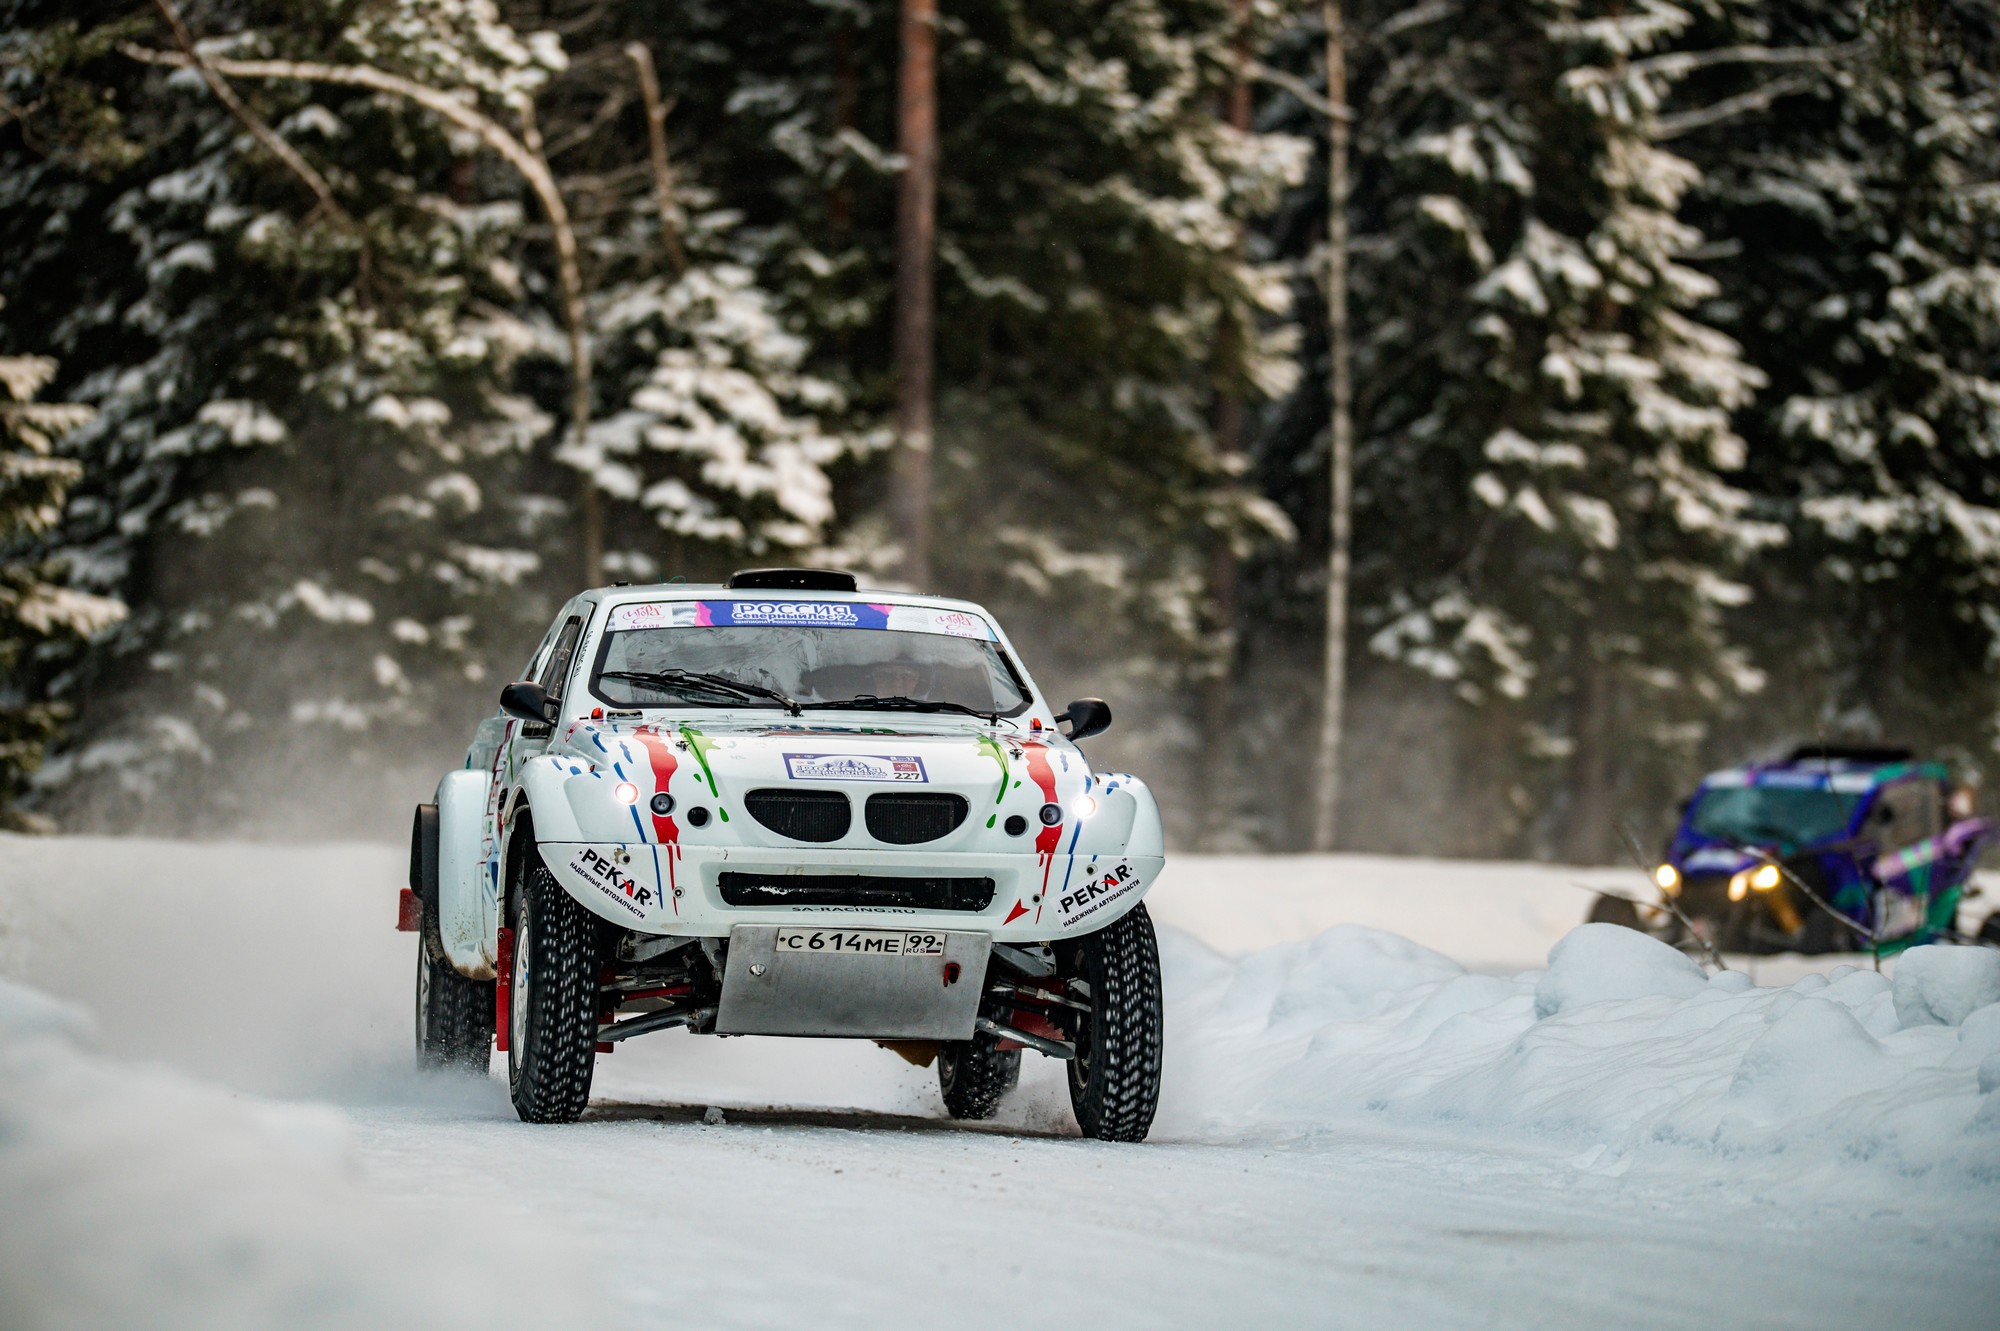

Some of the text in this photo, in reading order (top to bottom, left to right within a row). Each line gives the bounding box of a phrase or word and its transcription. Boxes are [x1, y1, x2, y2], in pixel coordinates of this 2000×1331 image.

[739, 603, 850, 615] РОССИЯ
[894, 772, 920, 780] 227
[569, 861, 646, 919] НАДЕЖНЫЕ АВТОЗАПЧАСТИ
[581, 848, 651, 906] PEKAR
[1060, 864, 1131, 914] PEKAR
[1063, 879, 1141, 928] НАДЕЖНЫЕ АВТОЗАПЧАСТИ
[909, 935, 936, 949] 99
